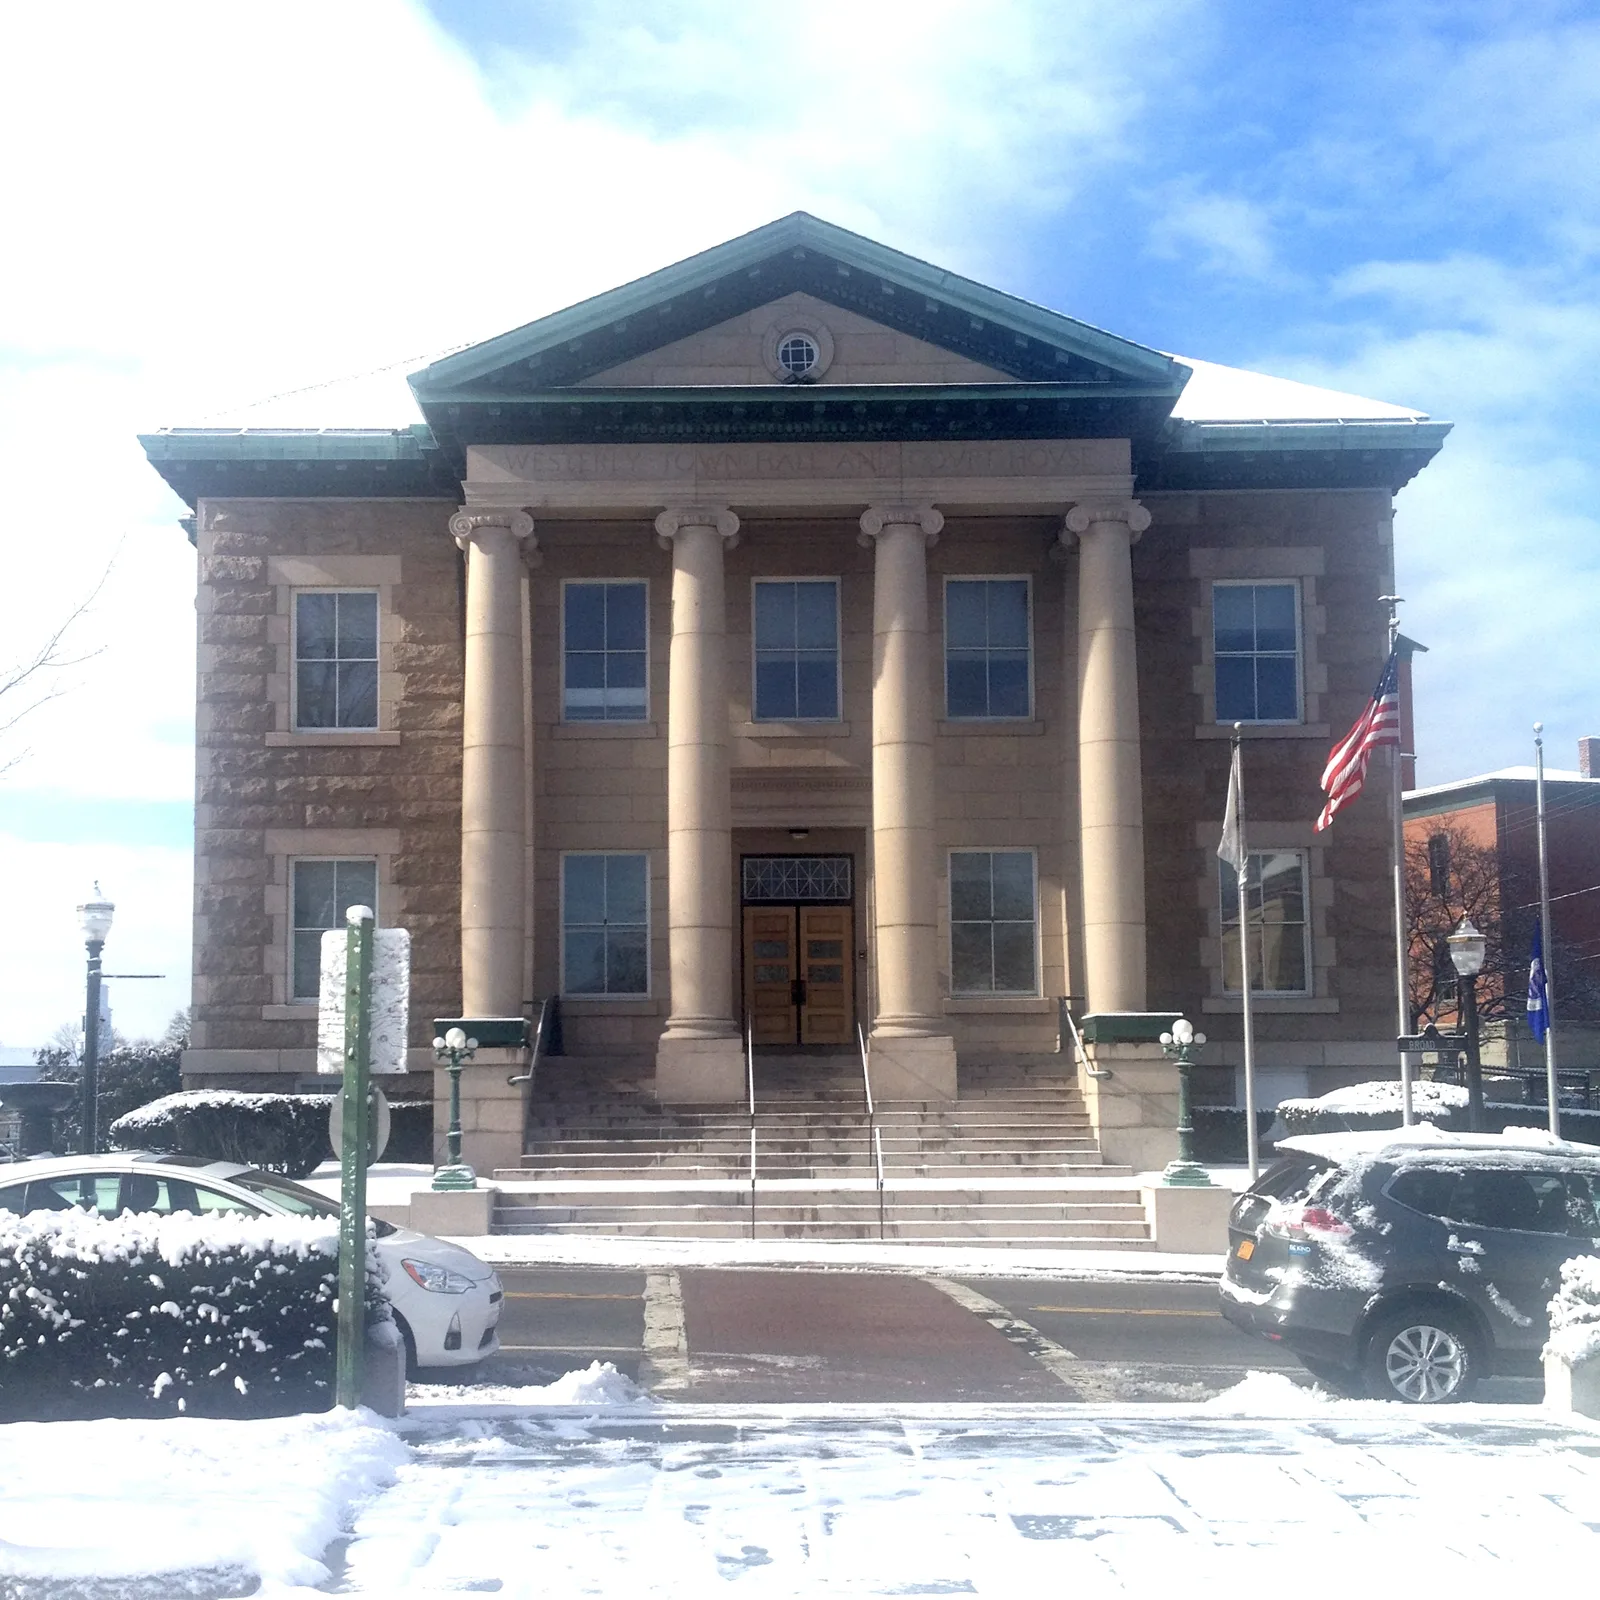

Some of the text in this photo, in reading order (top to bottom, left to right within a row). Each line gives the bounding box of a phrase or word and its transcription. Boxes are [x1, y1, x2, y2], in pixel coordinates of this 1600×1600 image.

[503, 450, 642, 473] WESTERLY
[659, 449, 742, 472] TOWN
[756, 449, 825, 471] HALL
[1409, 1040, 1435, 1050] BROAD
